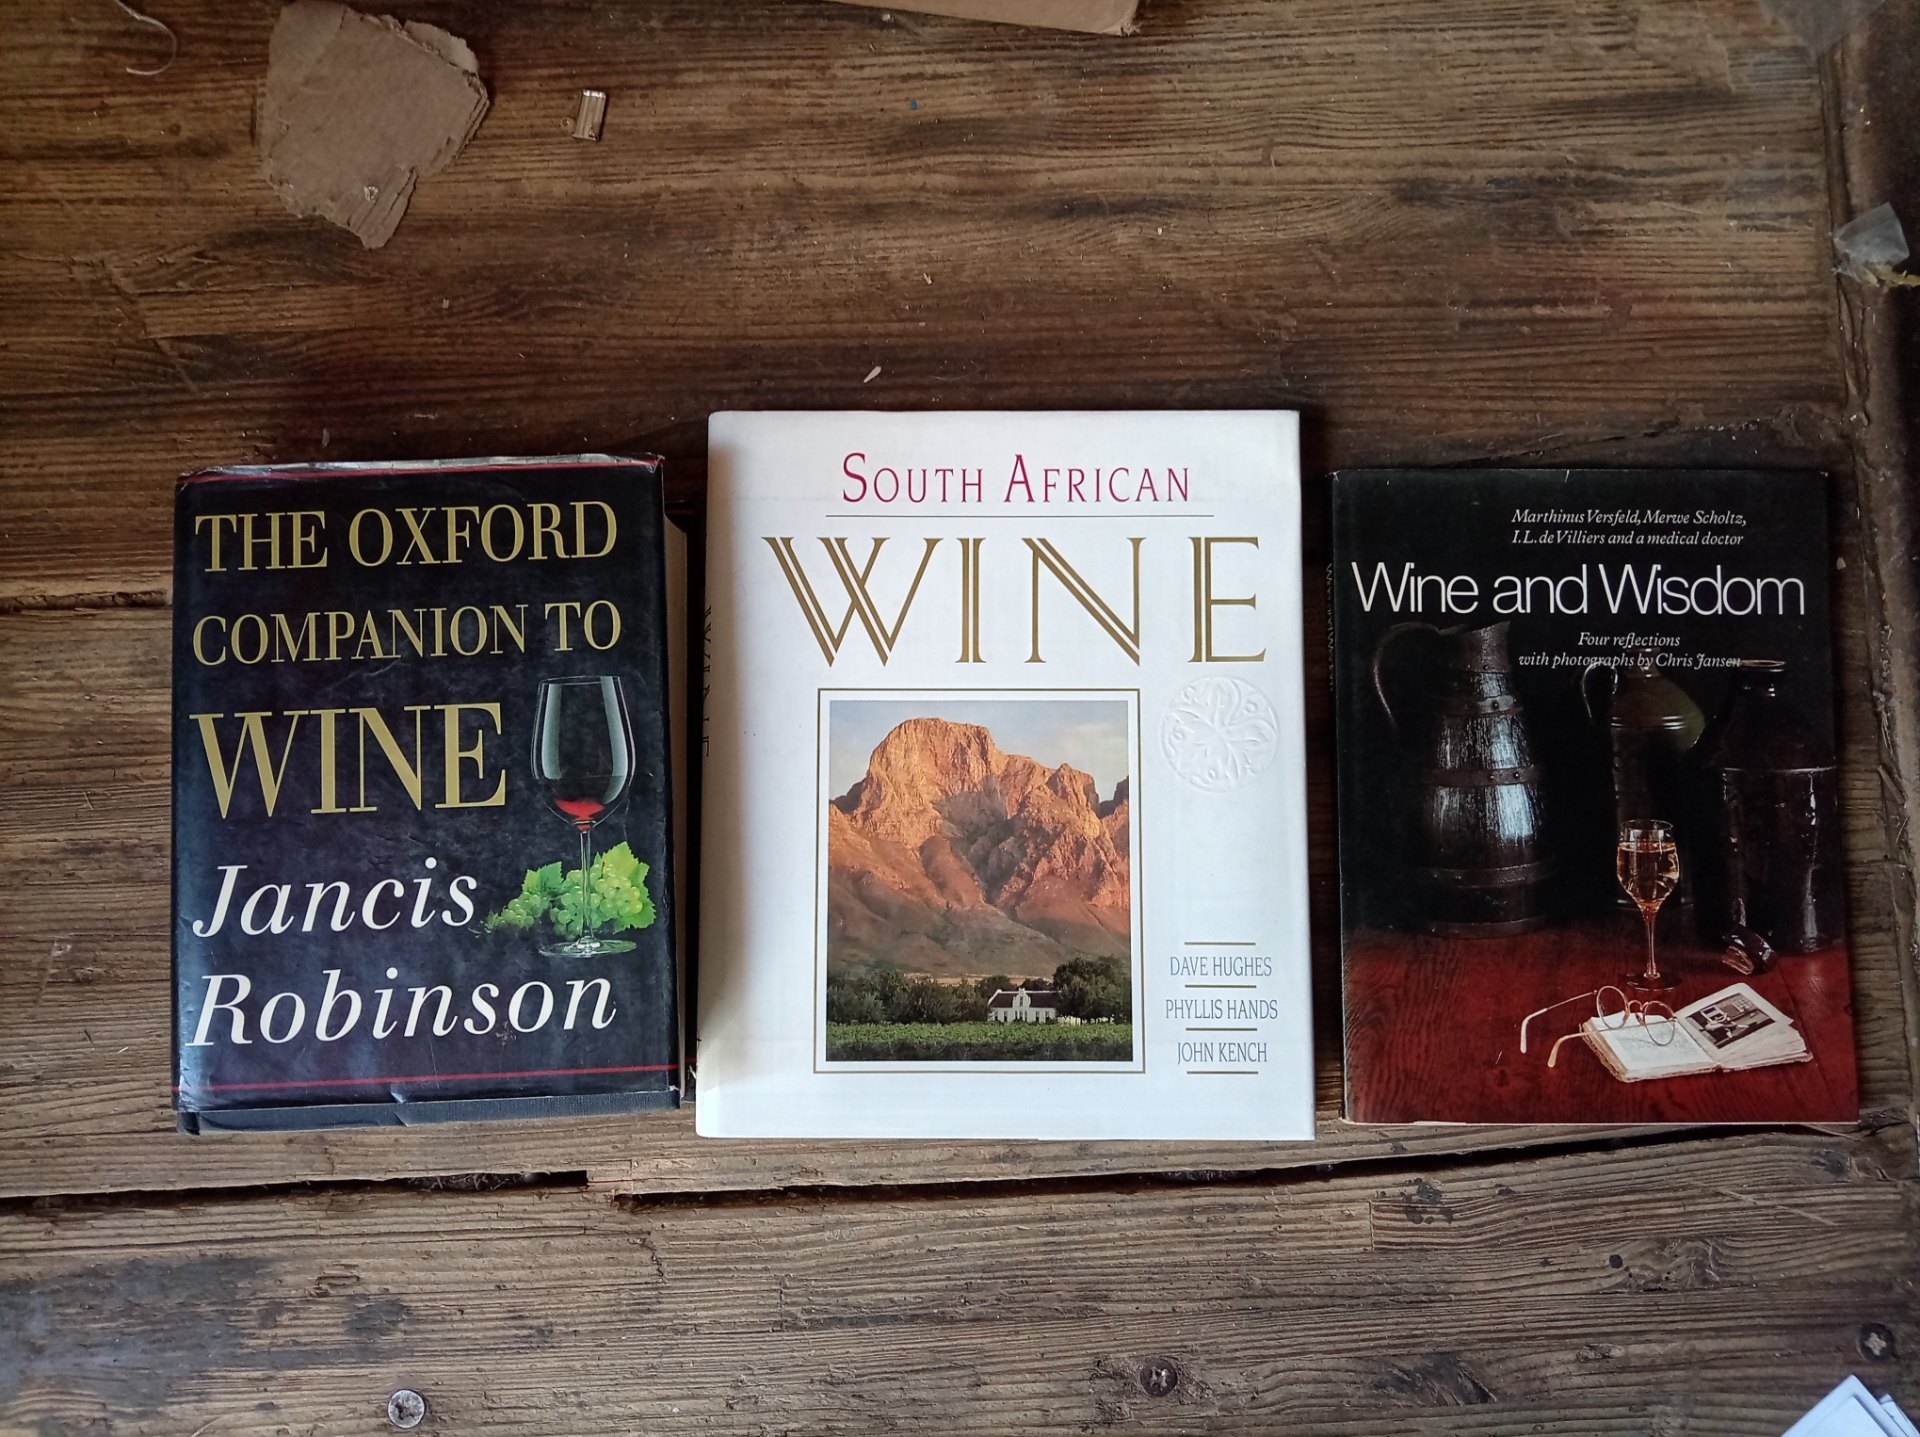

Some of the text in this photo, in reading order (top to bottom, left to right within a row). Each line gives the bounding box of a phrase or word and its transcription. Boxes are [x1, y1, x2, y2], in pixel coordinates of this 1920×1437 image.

[842, 452, 1190, 503] SOUTH AFRICAN
[195, 500, 618, 572] THE OXFORD
[1511, 508, 1747, 527] Marthinus Versfeld, Merwe Scholtz,
[1556, 530, 1605, 544] Villiers
[1608, 531, 1634, 545] and
[1635, 534, 1645, 545] a
[1647, 531, 1699, 546] medical
[1701, 531, 1744, 546] doctor
[761, 536, 1266, 667] WINE
[1351, 561, 1805, 616] Wine and Wisdom
[193, 600, 621, 665] COMPANION TO
[1578, 631, 1680, 649] Four reflections
[1519, 652, 1741, 671] with photographs by Chris Jansen
[189, 703, 507, 820] WINE
[193, 856, 477, 938] Jancis
[1169, 956, 1272, 977] DAVE HUGHES
[185, 967, 618, 1047] Robinson
[1165, 998, 1278, 1019] PHYLLIS HANDS
[1177, 1041, 1267, 1065] JOHN KENCH
